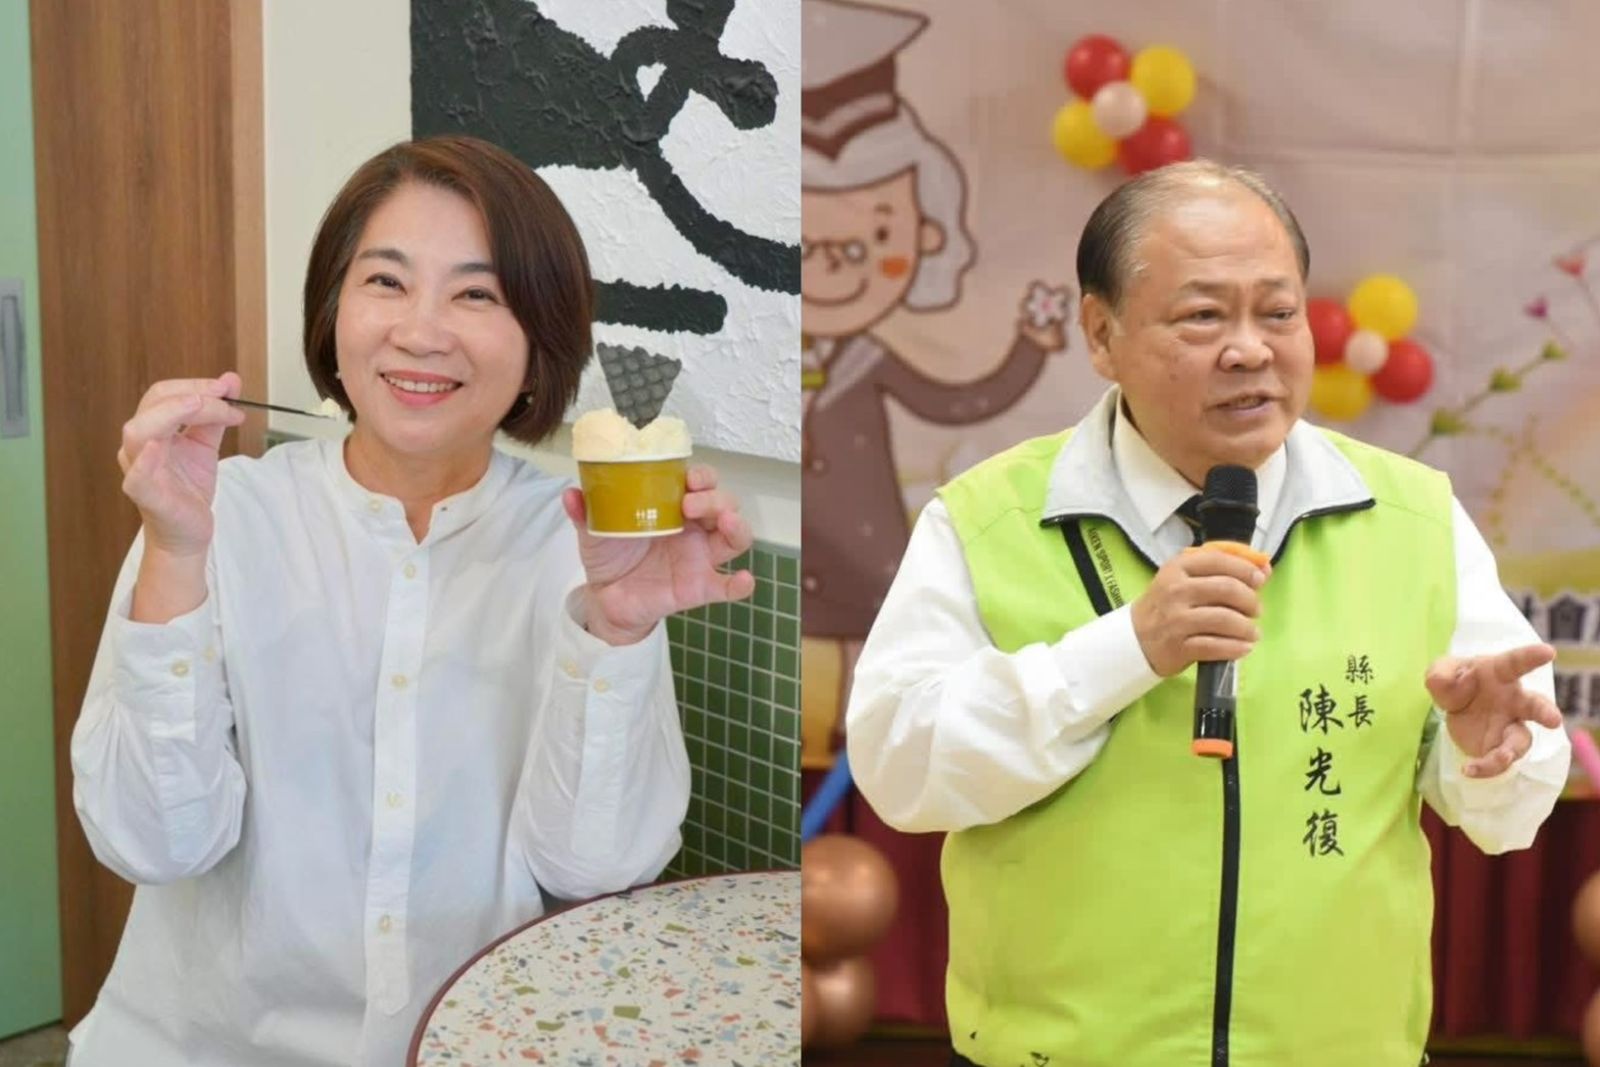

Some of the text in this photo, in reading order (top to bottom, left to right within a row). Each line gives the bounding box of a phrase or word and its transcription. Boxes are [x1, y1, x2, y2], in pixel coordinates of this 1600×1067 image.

[1096, 548, 1113, 573] SPORT
[1345, 655, 1375, 730] 縣長
[1299, 683, 1345, 857] 陳光復
